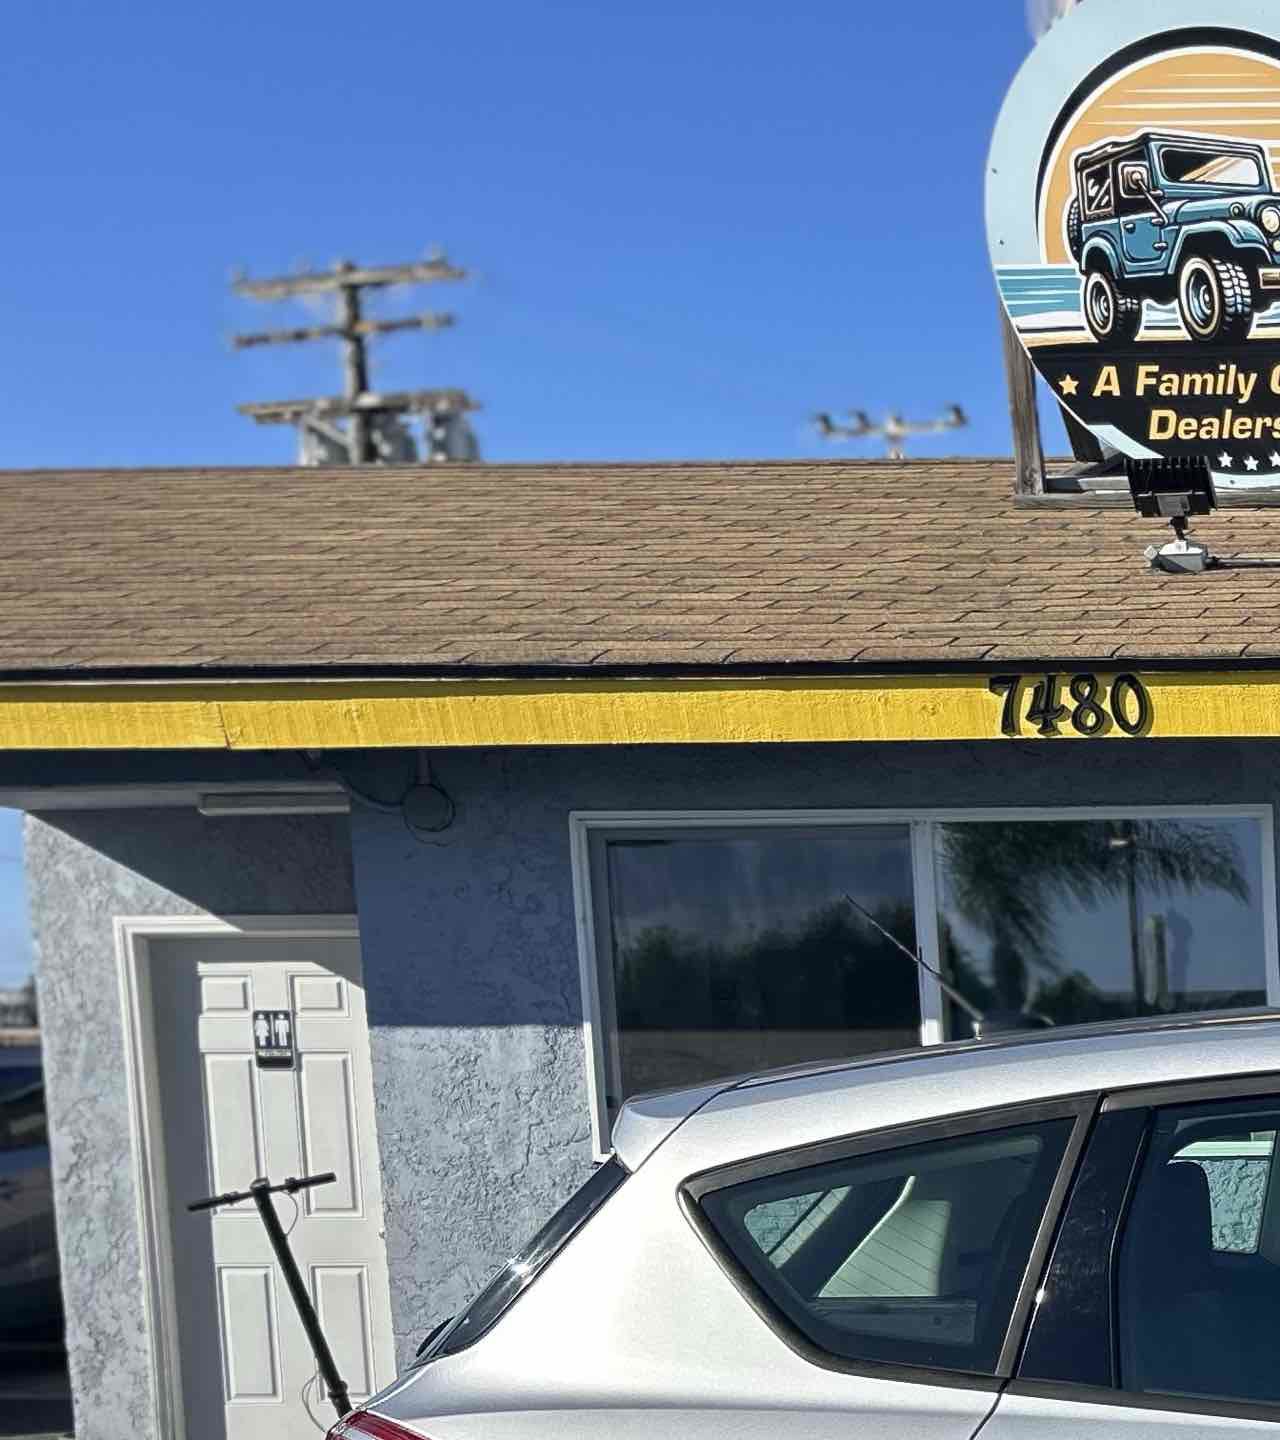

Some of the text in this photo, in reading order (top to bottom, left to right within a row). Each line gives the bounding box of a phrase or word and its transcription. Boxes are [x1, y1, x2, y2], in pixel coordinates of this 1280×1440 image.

[1092, 364, 1121, 397] A
[1135, 363, 1258, 404] Family
[988, 673, 1151, 737] 7480
